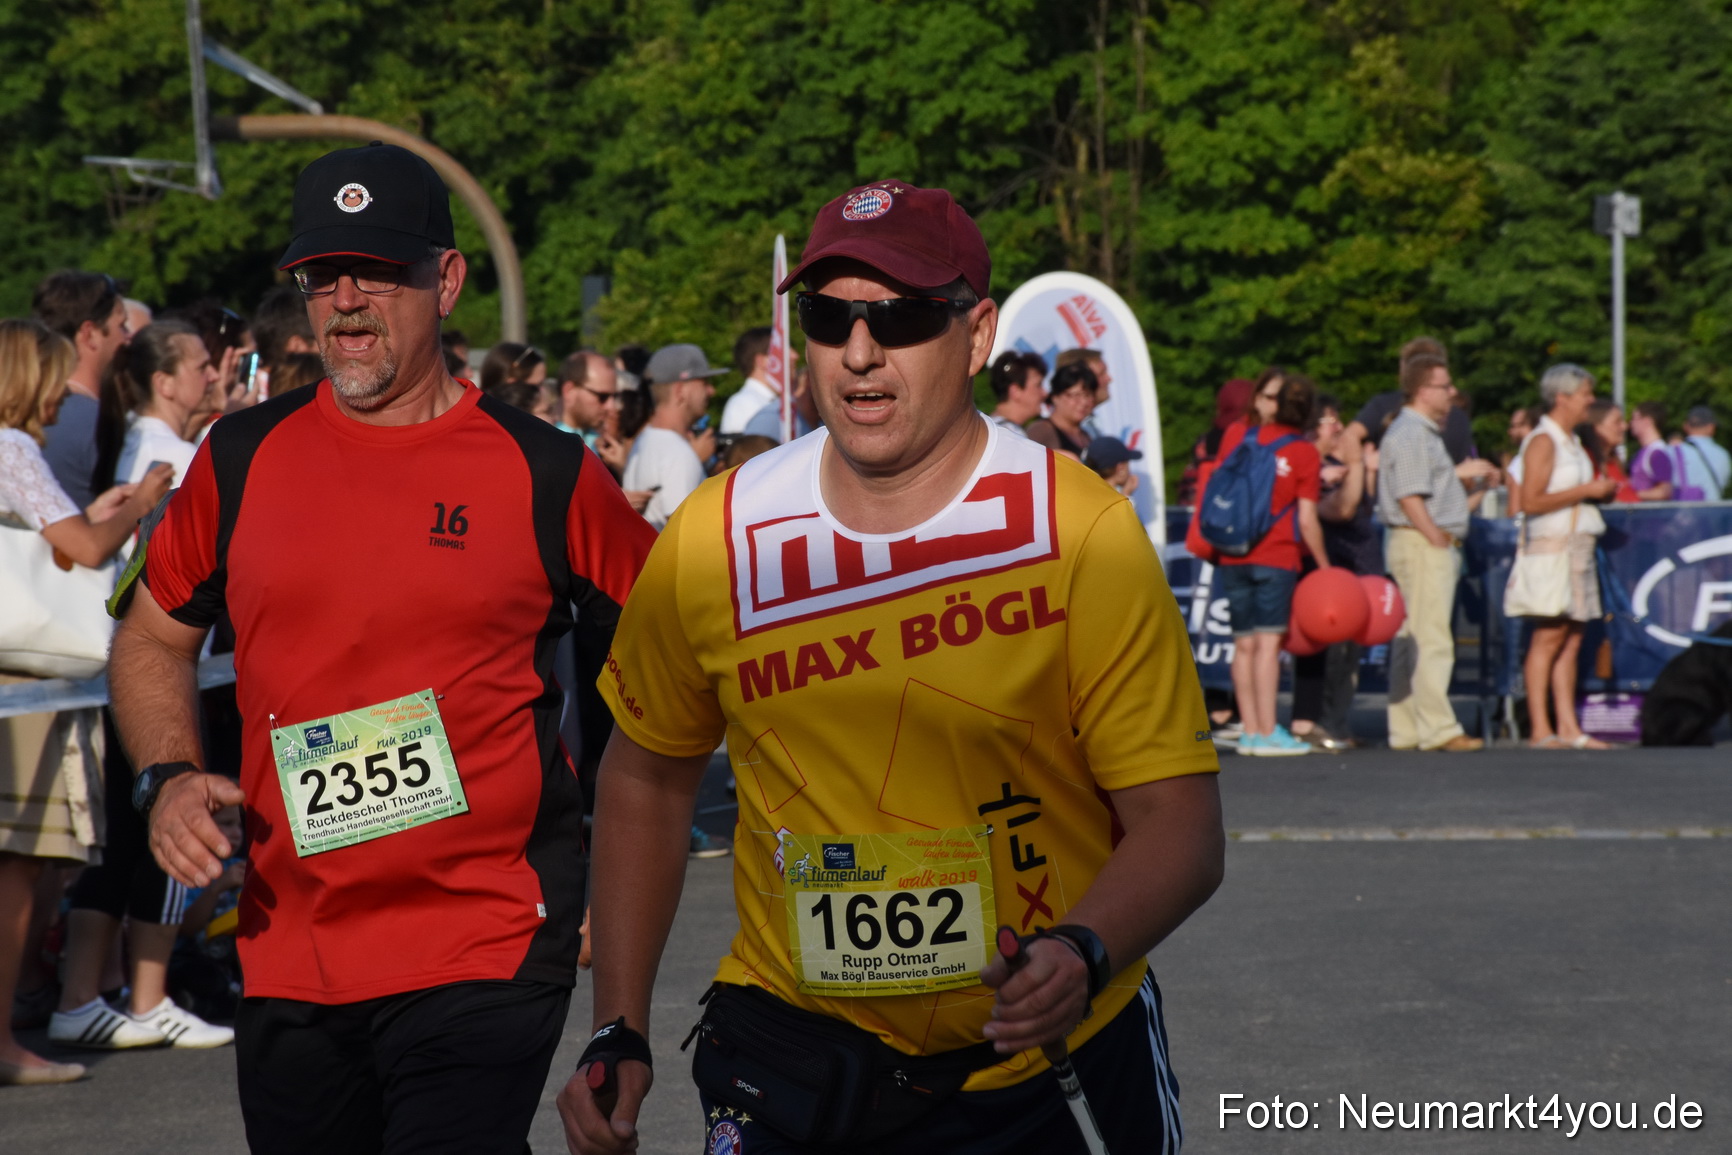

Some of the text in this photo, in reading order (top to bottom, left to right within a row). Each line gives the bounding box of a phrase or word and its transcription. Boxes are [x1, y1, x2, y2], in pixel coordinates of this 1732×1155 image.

[430, 502, 470, 537] 16
[429, 536, 465, 551] THOMAS
[737, 584, 1067, 704] MAX BÖGL
[298, 734, 359, 761] firmenlauf
[376, 725, 432, 749] run 2019
[300, 742, 431, 815] 2355
[303, 794, 453, 841] Trendhaus Handelsgesellschaft mbH
[306, 801, 387, 830] Ruckdeschel
[389, 786, 443, 808] Thomas
[907, 837, 974, 847] Gesunde Firmen
[812, 865, 887, 881] firmenlauf
[898, 869, 977, 889] walk 2019
[811, 888, 967, 951] 1662
[842, 951, 939, 970] Rupp Otmar
[820, 970, 840, 981] Max
[841, 970, 865, 983] Bögl
[868, 968, 928, 980] Bauservice
[931, 963, 966, 976] GmbH
[736, 1079, 760, 1097] SPORT
